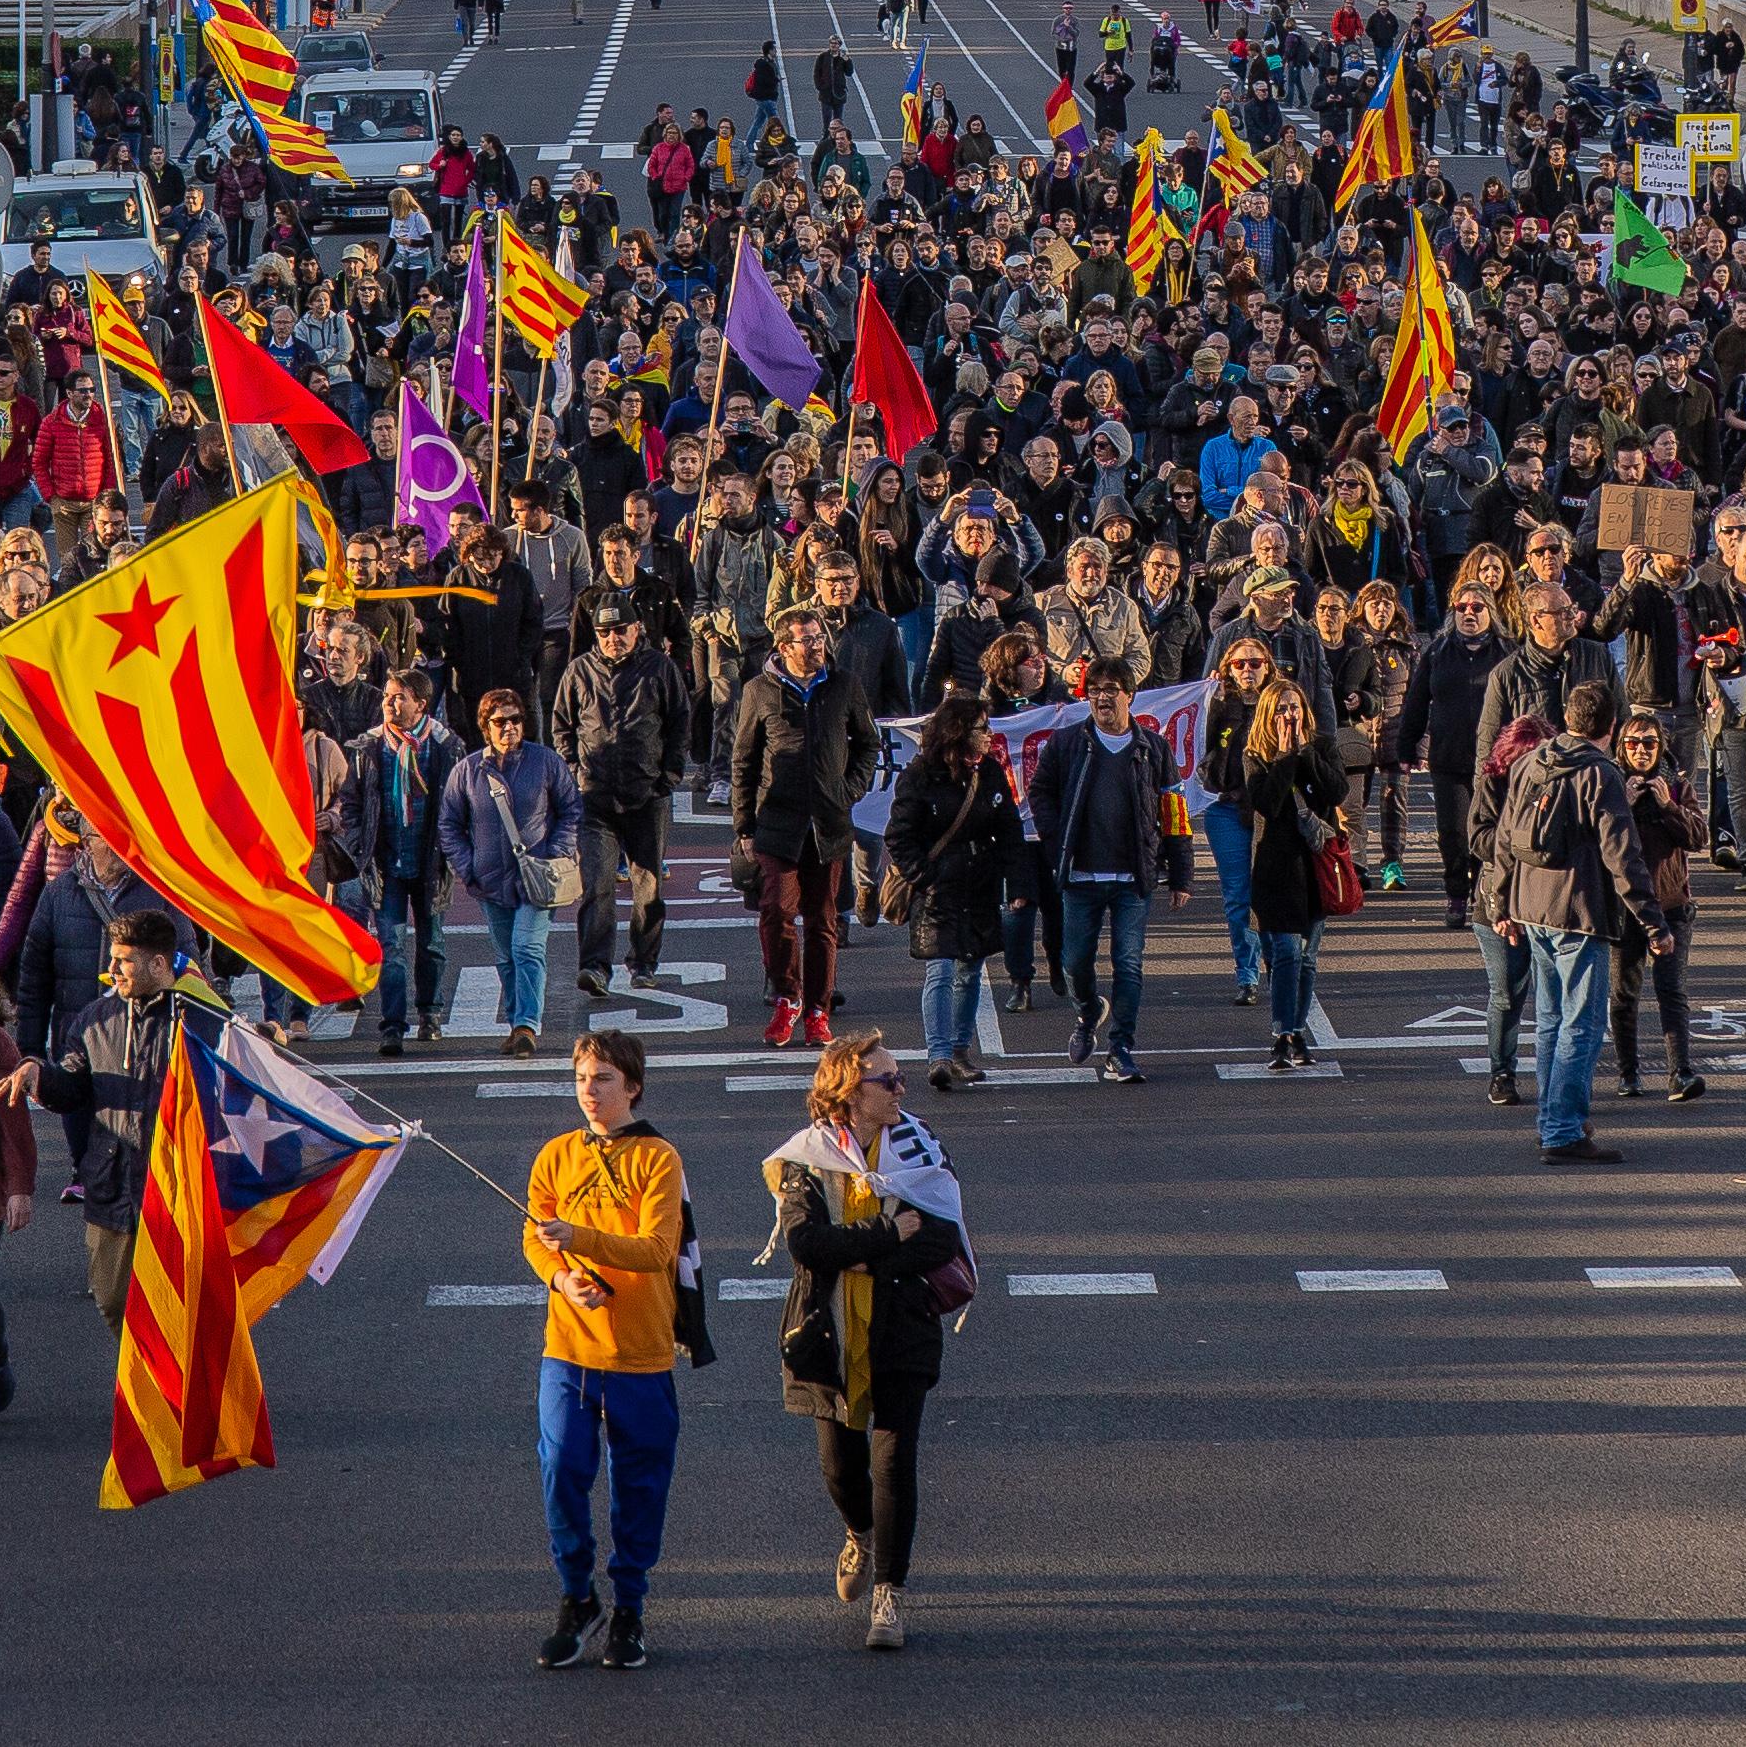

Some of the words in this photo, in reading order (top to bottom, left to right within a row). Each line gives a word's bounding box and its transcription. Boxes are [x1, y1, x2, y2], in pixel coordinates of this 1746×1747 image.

[1686, 121, 1731, 131] freedom
[1698, 133, 1717, 142] for
[1682, 141, 1733, 153] Catalonia
[1605, 491, 1637, 508] LOS
[1646, 492, 1689, 513] REYES
[1607, 511, 1627, 524] EN
[1637, 514, 1663, 526] LOS
[1602, 528, 1689, 549] CUENTOS
